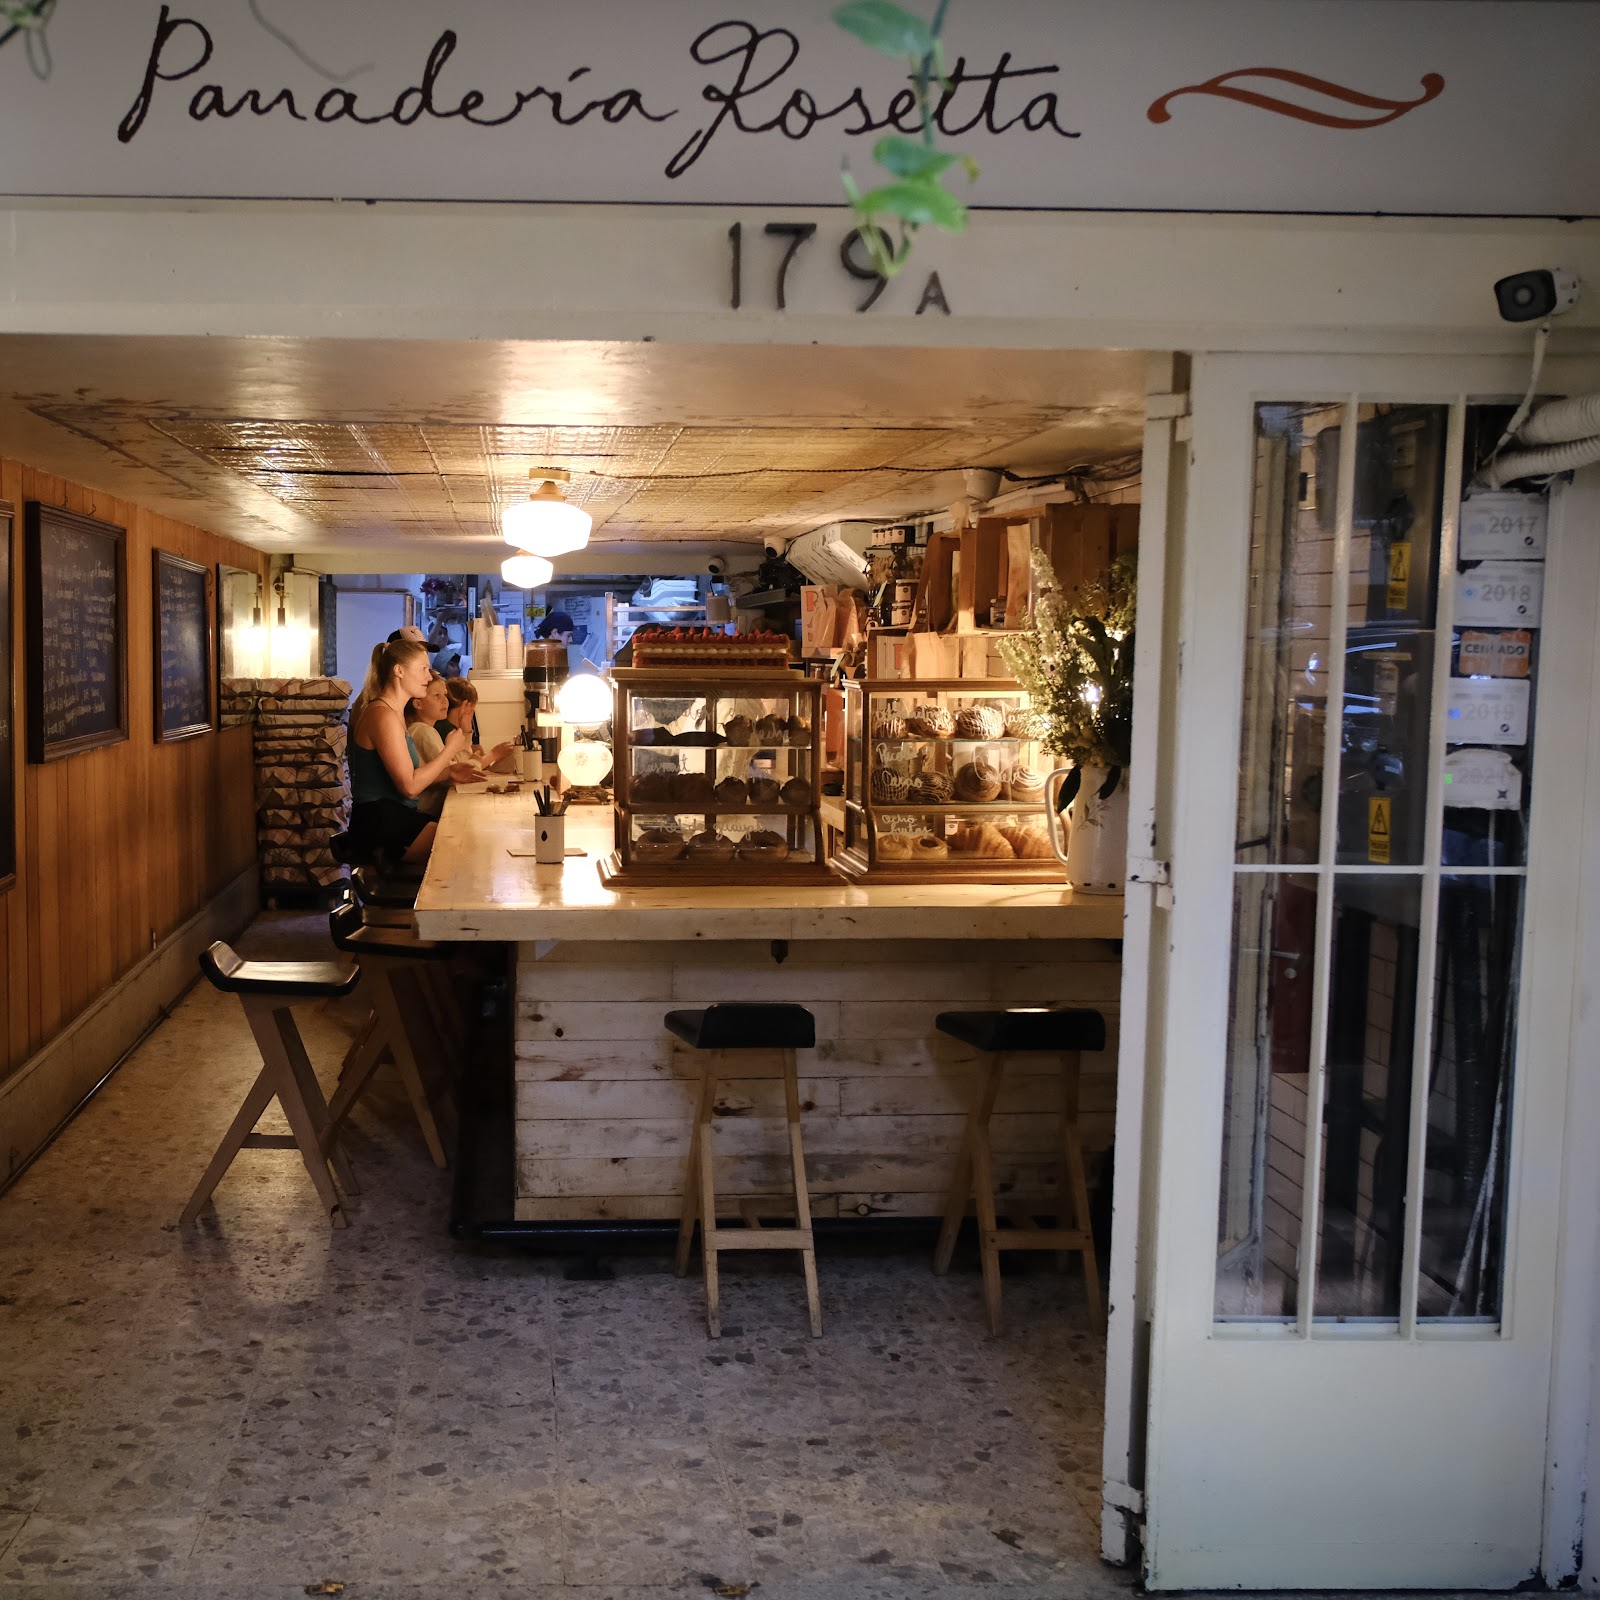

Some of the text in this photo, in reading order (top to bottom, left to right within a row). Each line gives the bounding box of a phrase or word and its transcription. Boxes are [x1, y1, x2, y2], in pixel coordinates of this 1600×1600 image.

[665, 21, 1080, 178] Rosetta
[1488, 516, 1538, 534] 2017
[1481, 584, 1530, 602] 2018
[1464, 643, 1526, 655] CEADO
